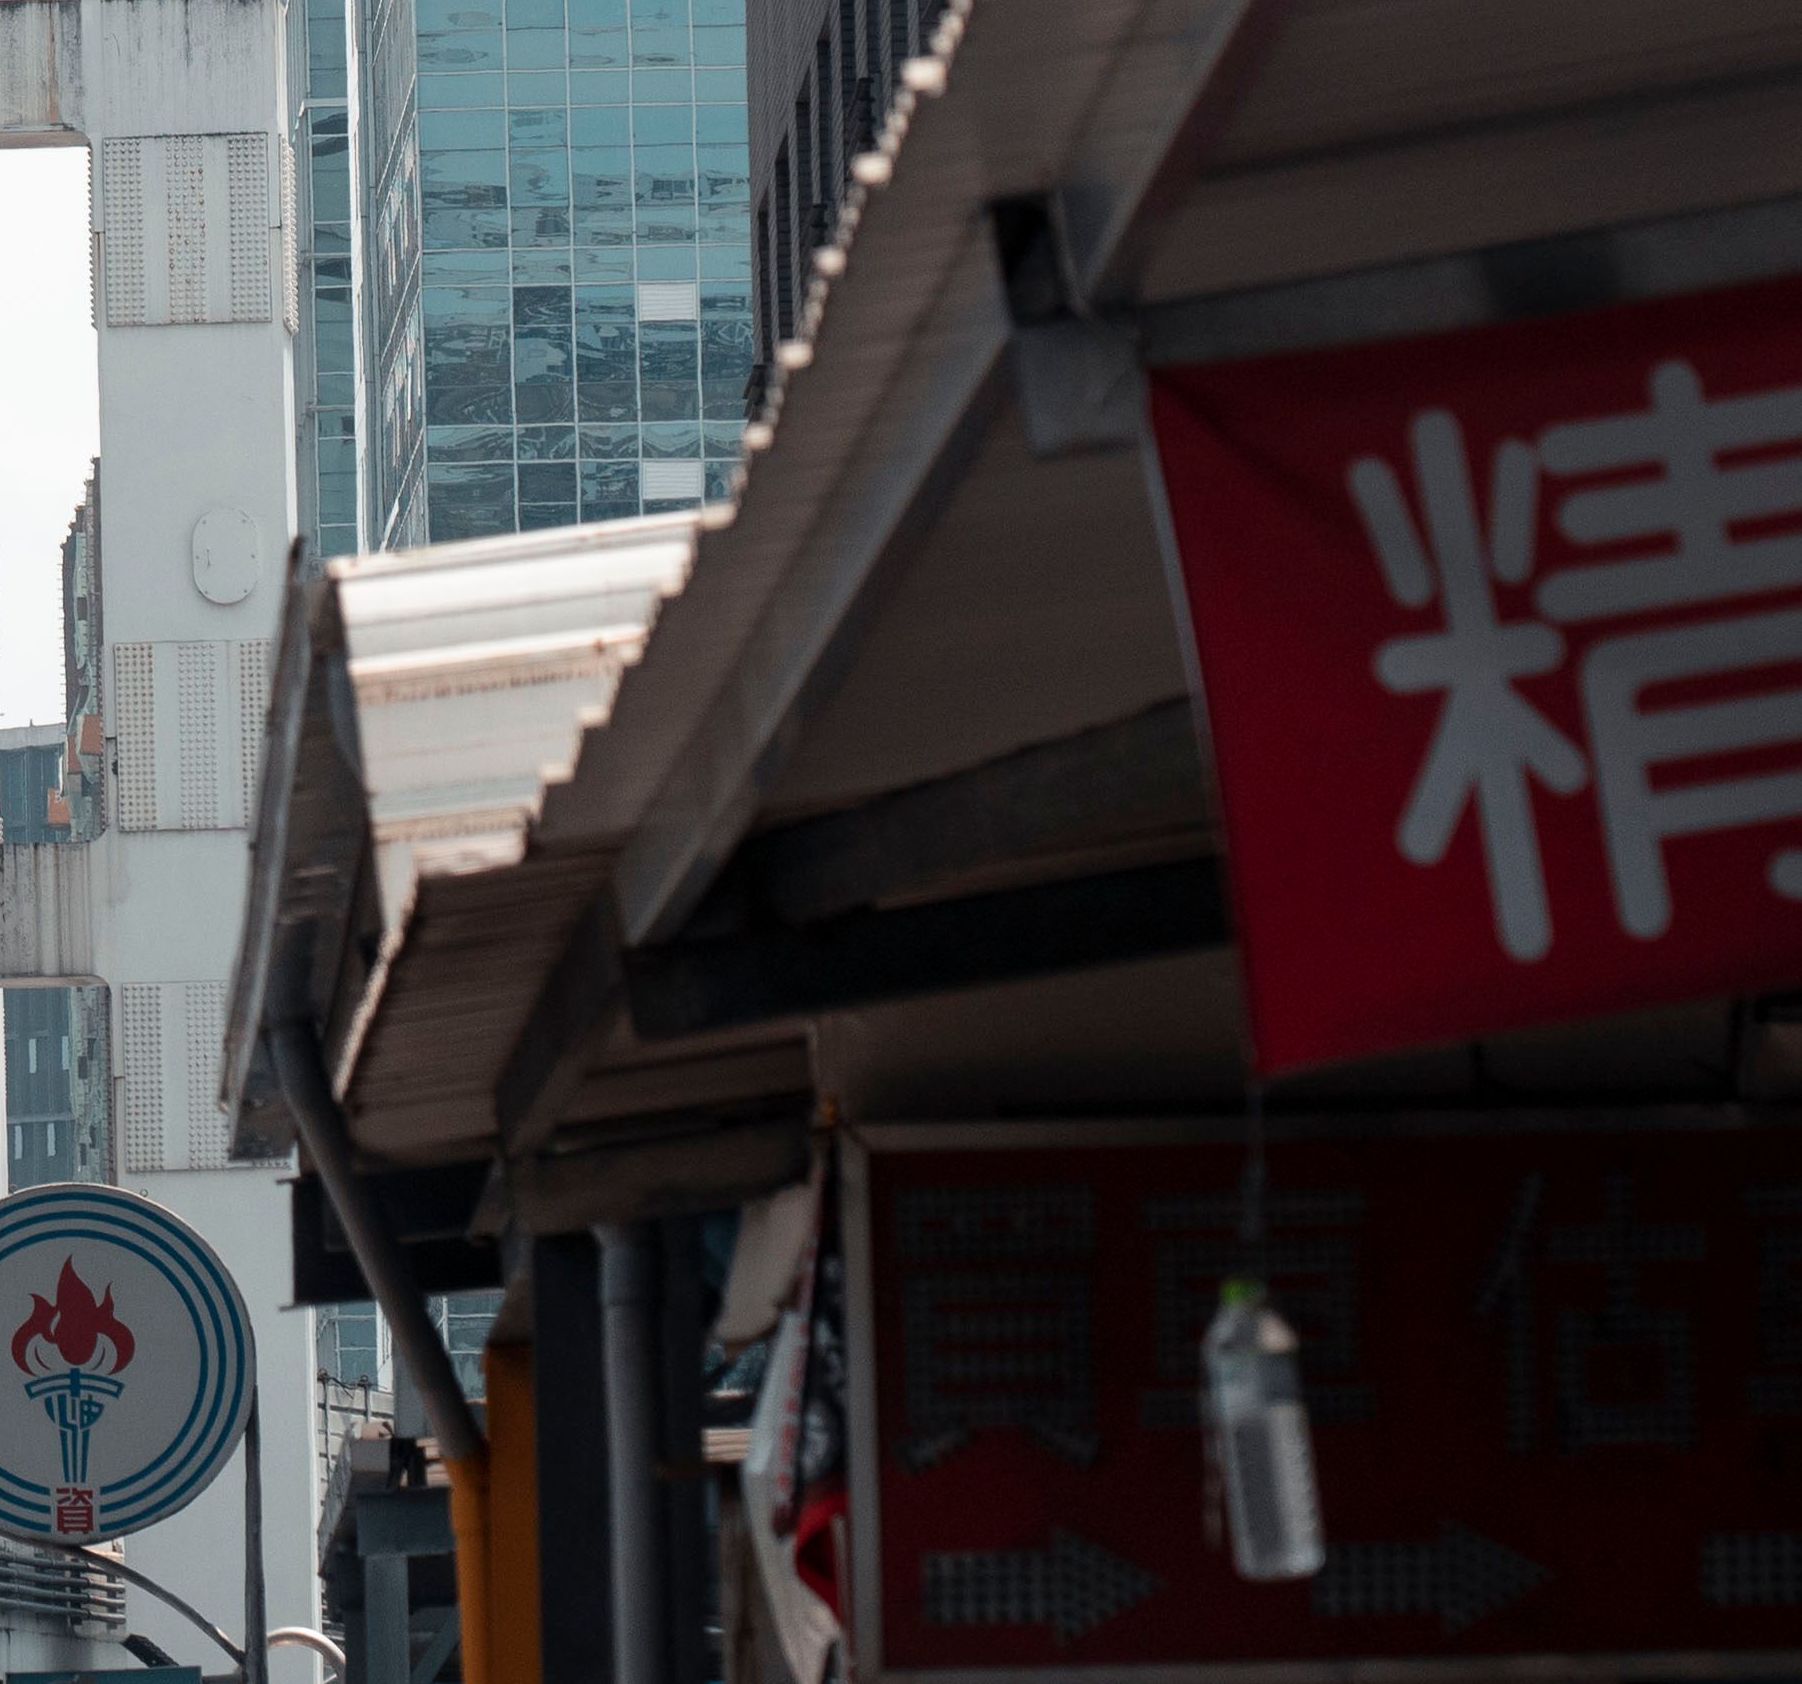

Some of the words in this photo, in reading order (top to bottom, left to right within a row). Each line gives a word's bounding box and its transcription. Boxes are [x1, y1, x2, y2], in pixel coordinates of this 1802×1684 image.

[892, 1168, 1802, 1473] 買車估
[56, 1487, 93, 1534] 資
